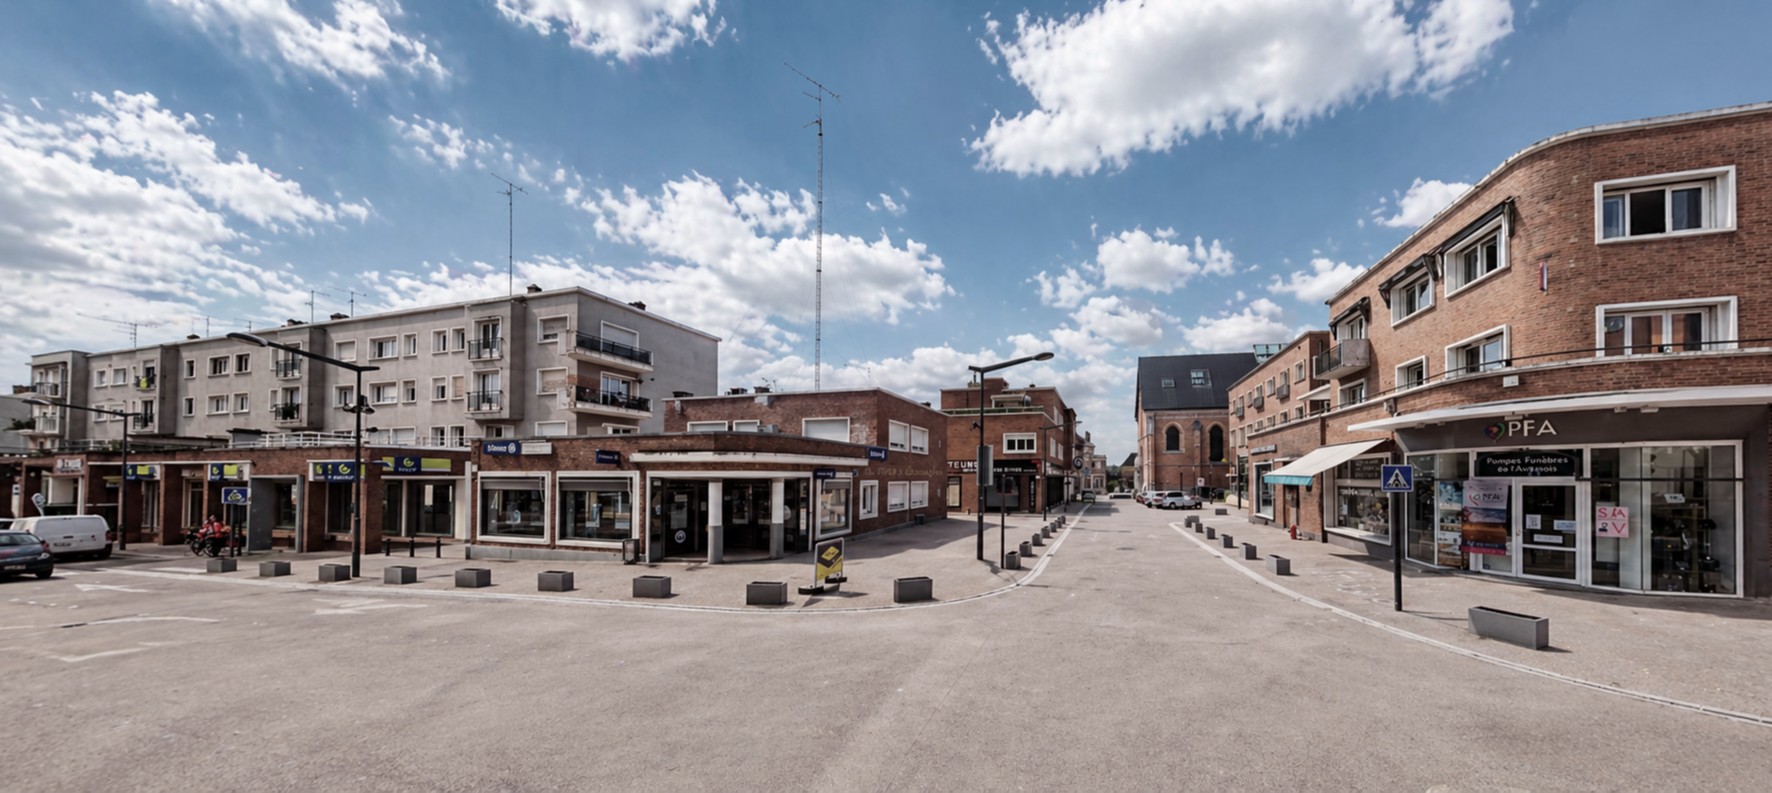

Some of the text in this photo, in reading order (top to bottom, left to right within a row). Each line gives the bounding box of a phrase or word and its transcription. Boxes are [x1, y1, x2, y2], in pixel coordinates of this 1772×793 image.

[1508, 419, 1557, 437] PFA
[1487, 455, 1569, 466] Pompes Funèbres
